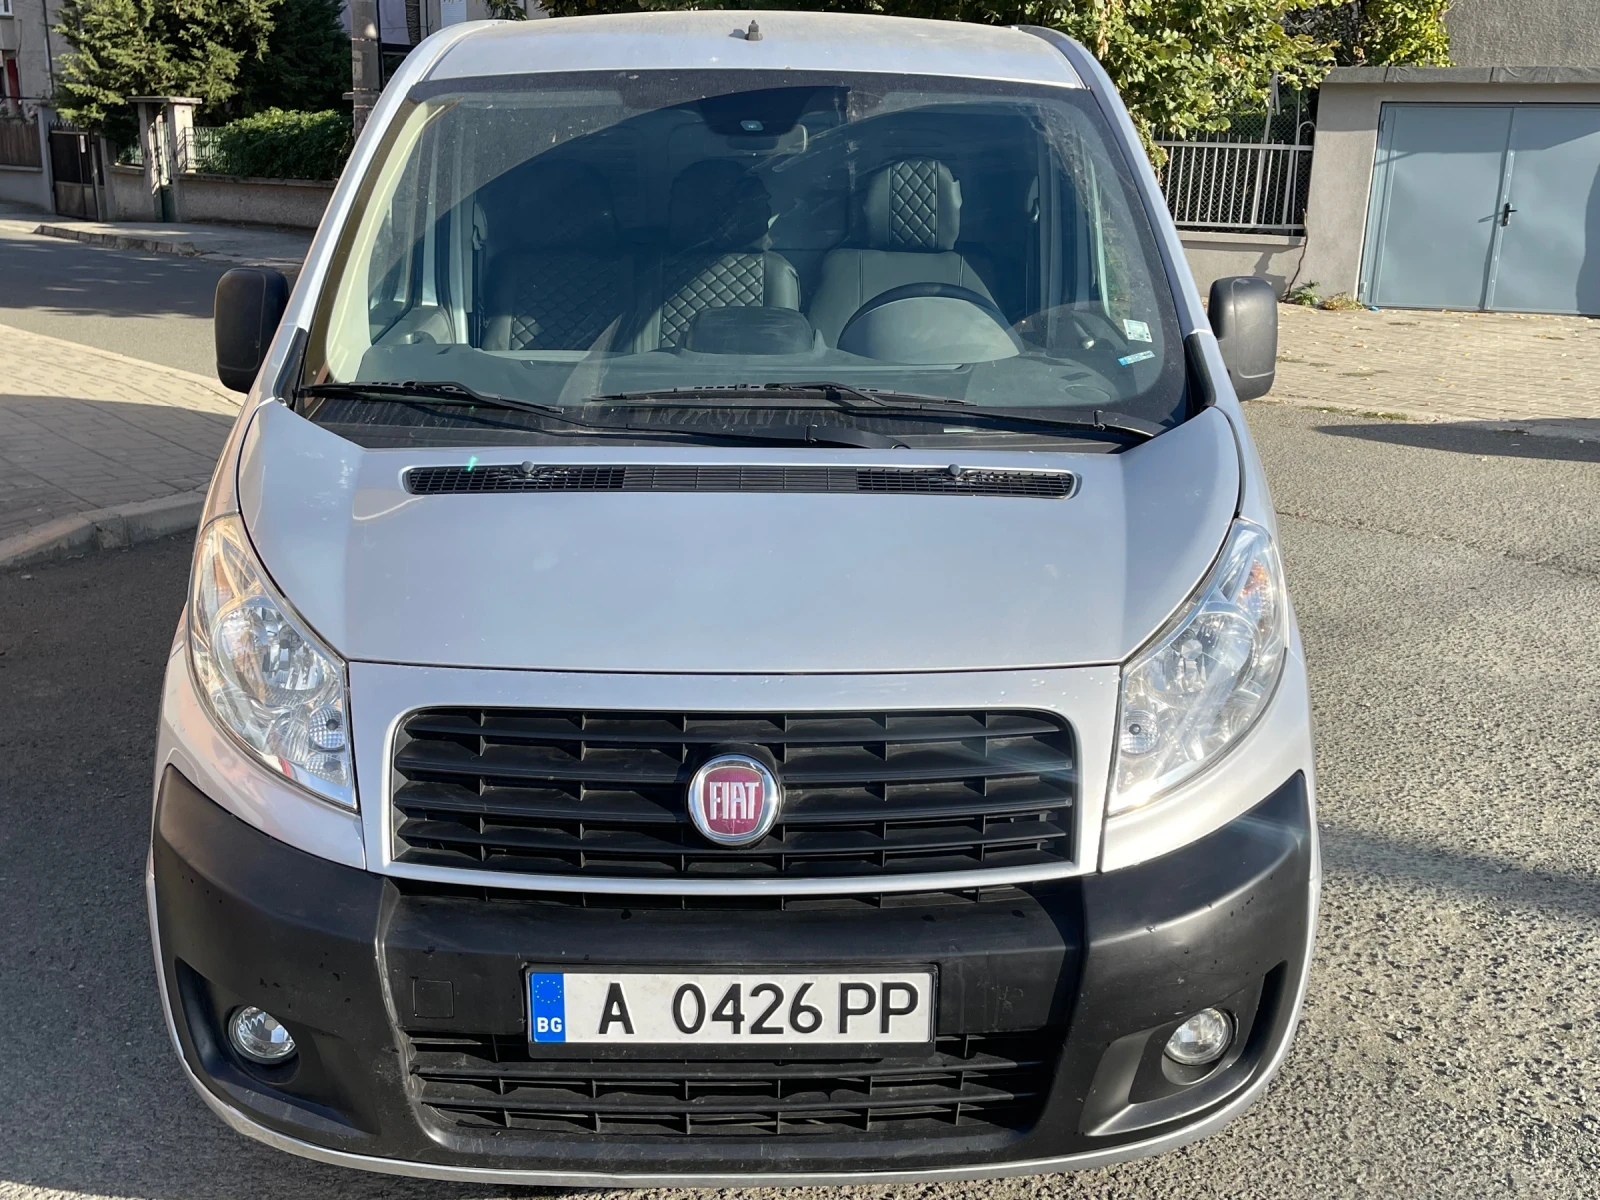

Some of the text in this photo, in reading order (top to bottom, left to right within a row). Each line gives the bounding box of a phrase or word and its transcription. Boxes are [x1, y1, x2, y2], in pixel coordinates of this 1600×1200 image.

[709, 781, 760, 820] FIAT
[537, 1017, 563, 1033] BG
[598, 981, 919, 1035] A 0426 PP
